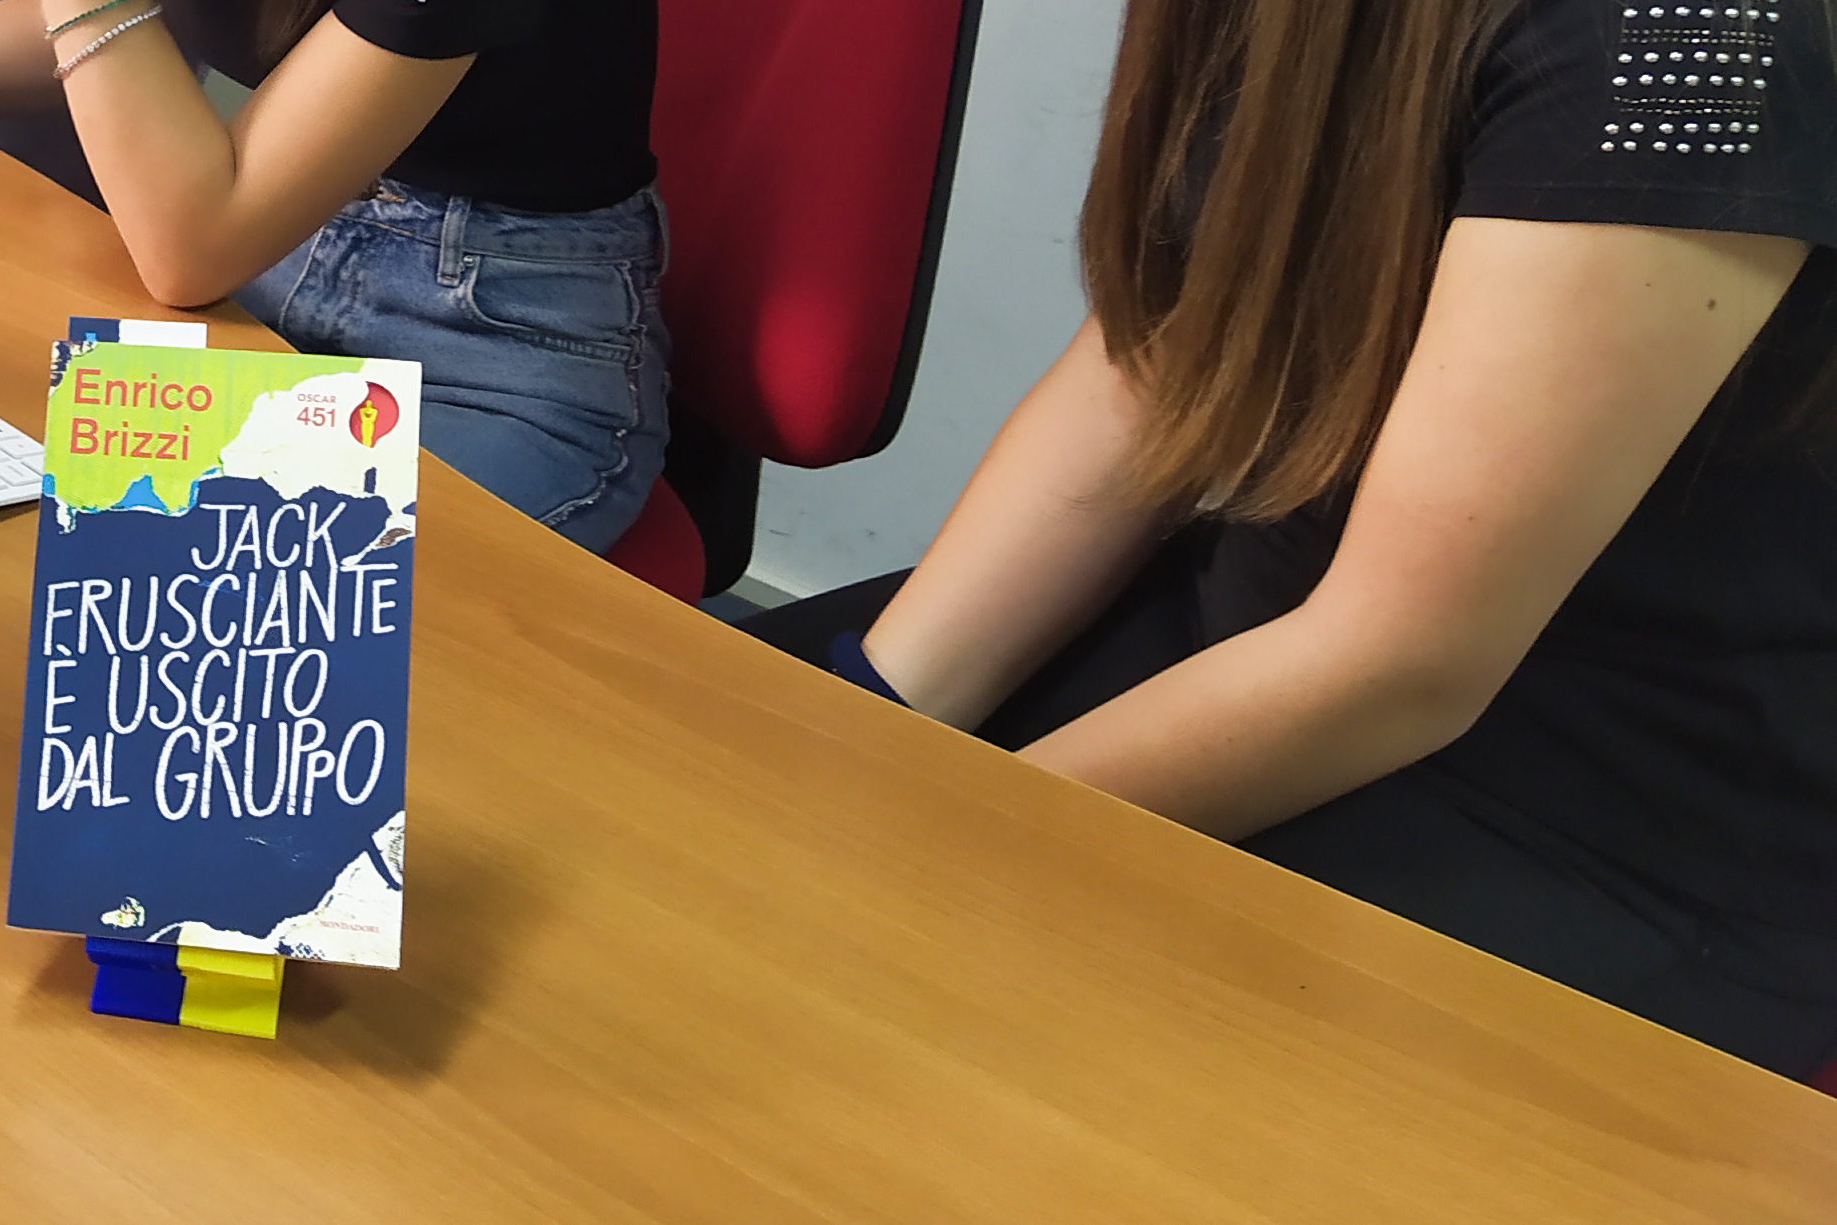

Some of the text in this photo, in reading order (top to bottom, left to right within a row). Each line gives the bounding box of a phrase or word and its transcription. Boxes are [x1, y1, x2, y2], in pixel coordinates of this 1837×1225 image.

[74, 368, 213, 412] Enrico
[297, 393, 337, 404] OSCAR
[70, 417, 190, 461] Brizzi
[296, 406, 336, 428] 451
[190, 501, 348, 571] JACK
[43, 563, 399, 657] FRUSCIANTE
[44, 644, 329, 735] È USCITO
[36, 717, 386, 821] DAL GRUPPO
[319, 920, 380, 933] MONDADORI
